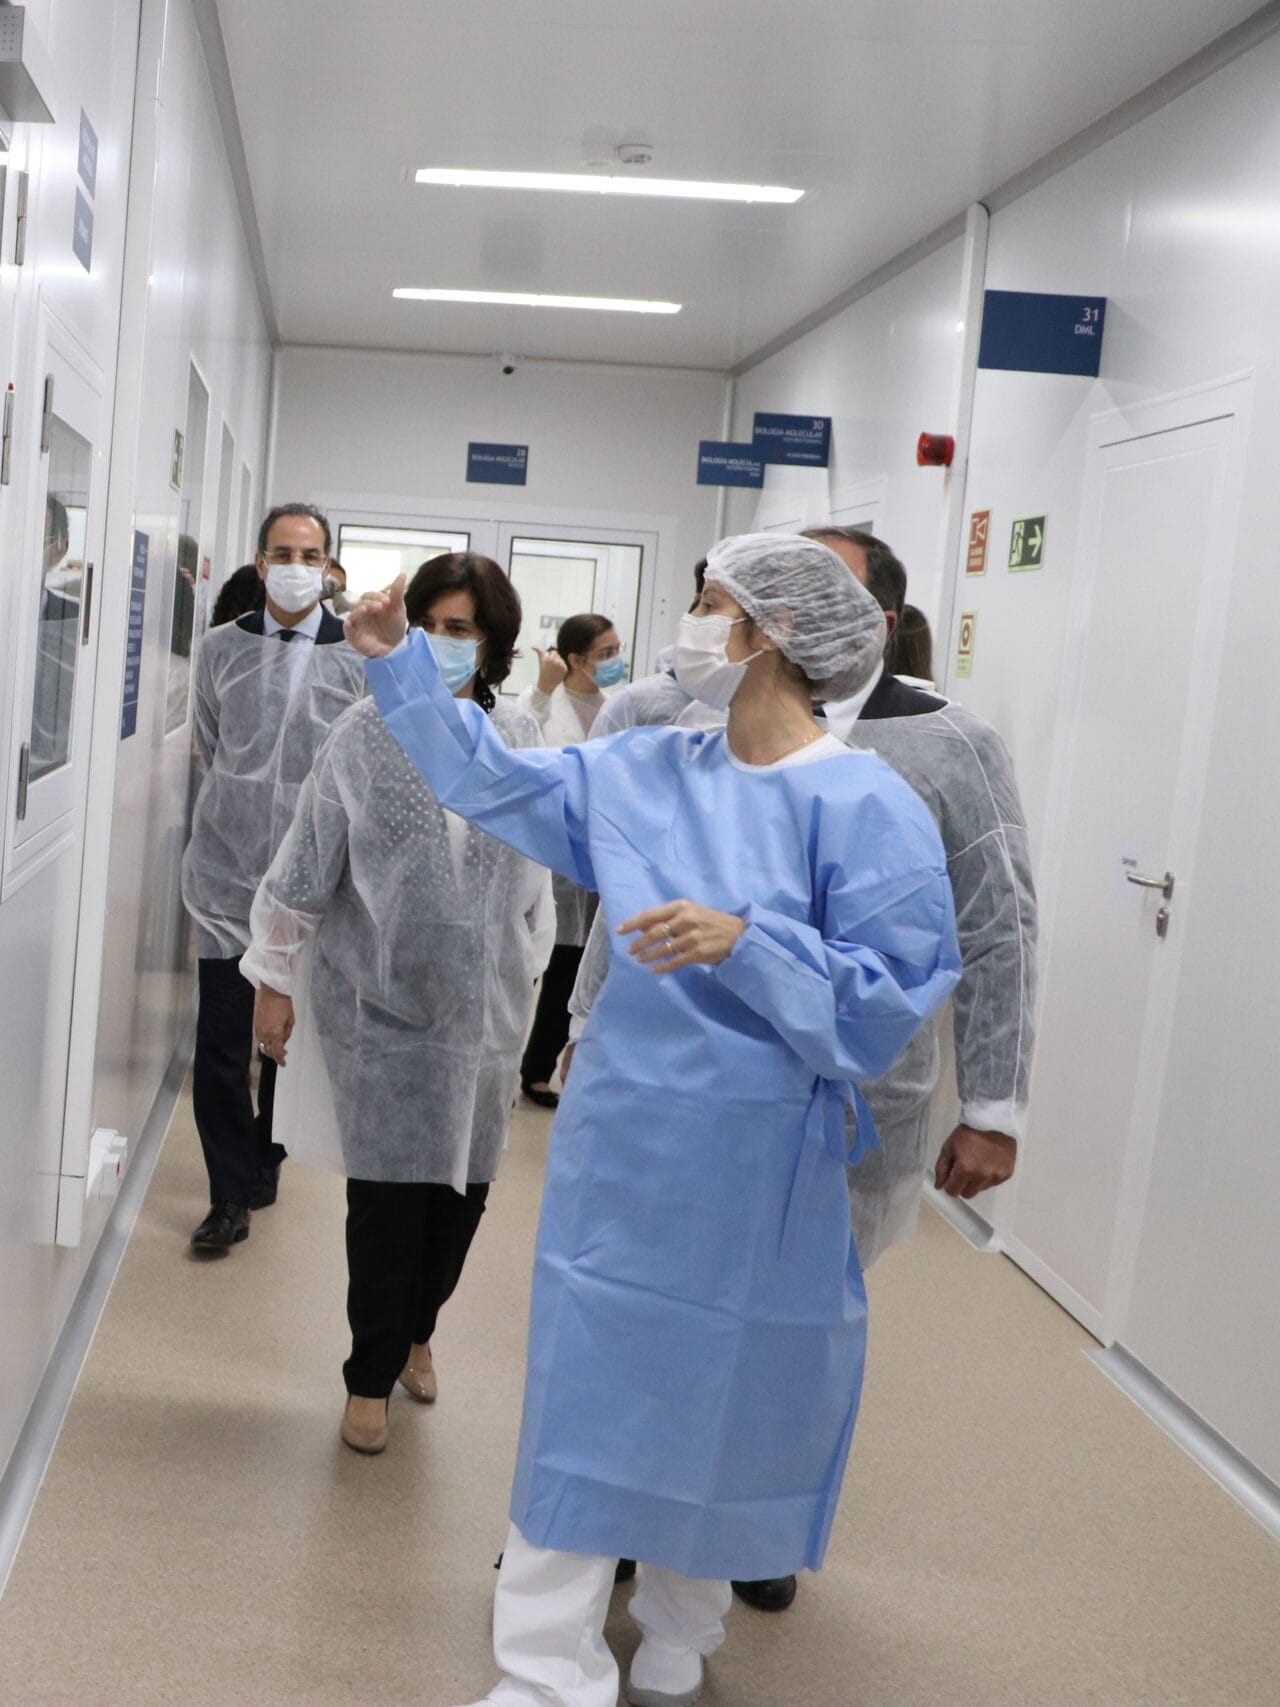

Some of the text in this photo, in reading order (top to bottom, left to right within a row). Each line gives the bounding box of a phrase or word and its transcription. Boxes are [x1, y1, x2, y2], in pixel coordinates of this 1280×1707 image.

[1082, 307, 1099, 322] 31
[1074, 324, 1096, 335] DML
[812, 420, 824, 430] 30
